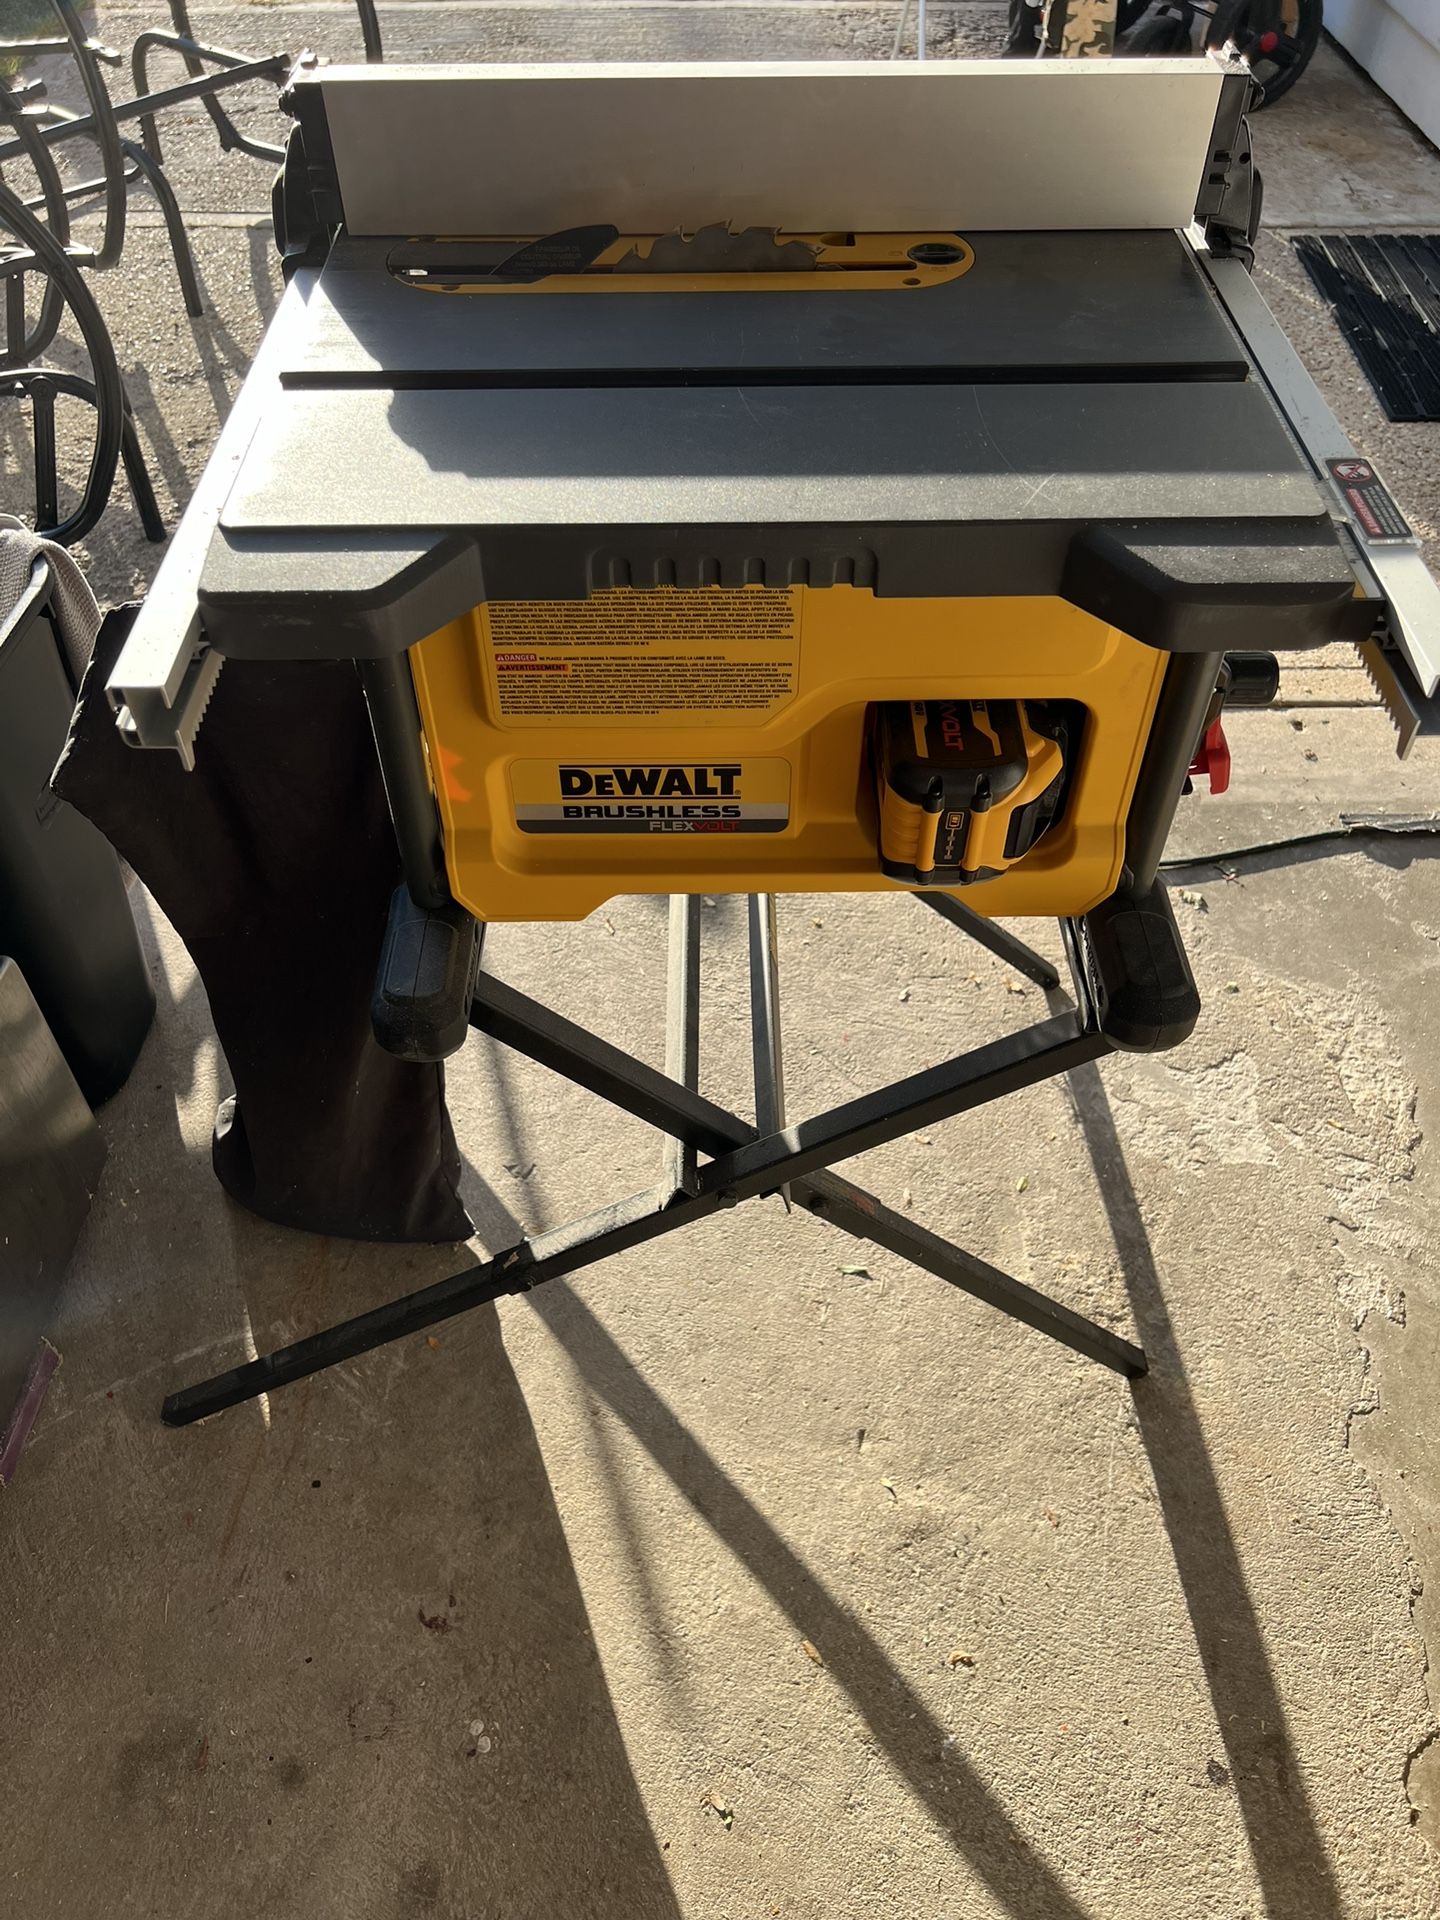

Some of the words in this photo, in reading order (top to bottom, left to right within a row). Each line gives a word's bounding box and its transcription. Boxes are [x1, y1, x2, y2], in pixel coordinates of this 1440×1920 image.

[559, 768, 741, 795] DEWALT
[562, 805, 741, 818] BRUSHLESS
[649, 821, 740, 831] FLEXVOLT
